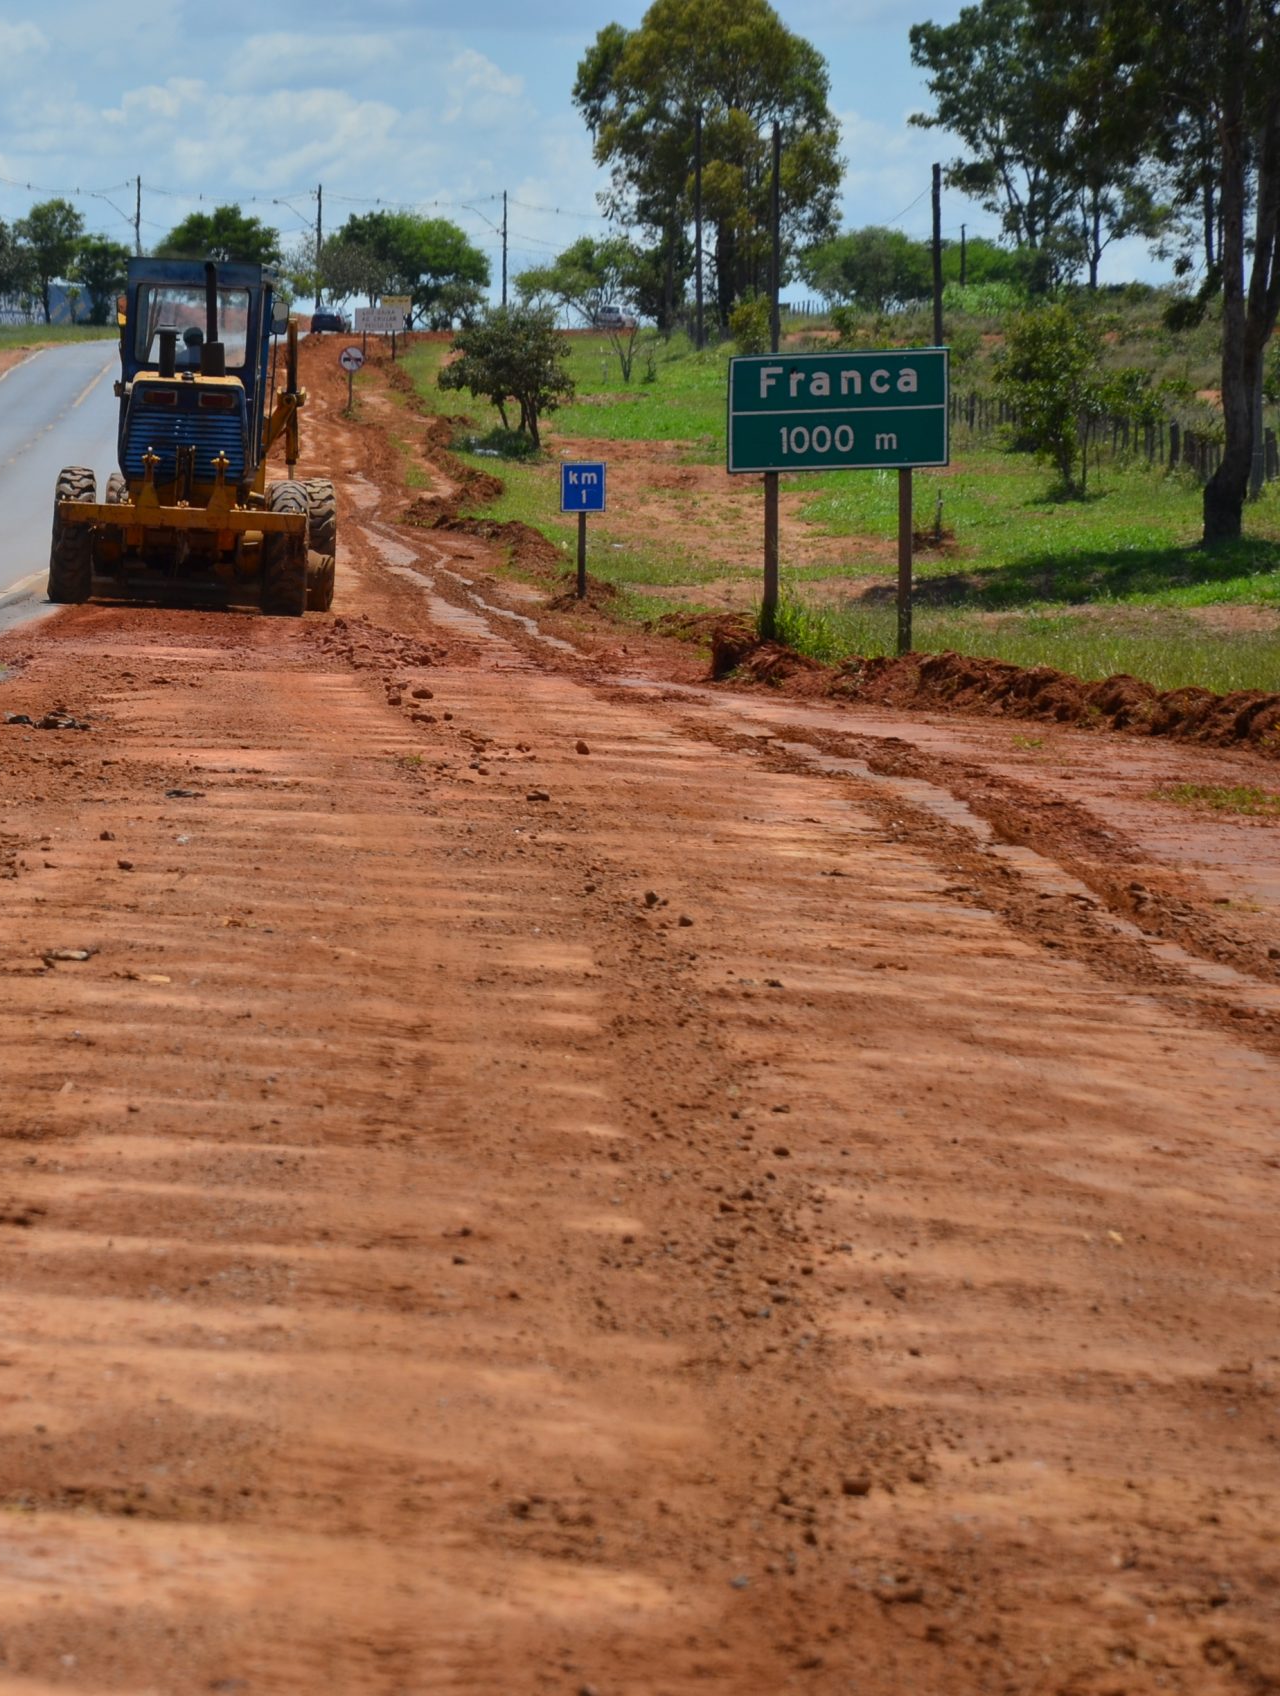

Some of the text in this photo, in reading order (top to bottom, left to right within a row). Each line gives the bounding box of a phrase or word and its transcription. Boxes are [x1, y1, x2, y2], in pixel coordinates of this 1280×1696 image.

[760, 367, 918, 398] Franca
[779, 425, 898, 454] 1000 m
[569, 470, 597, 485] km
[581, 489, 587, 504] 1
